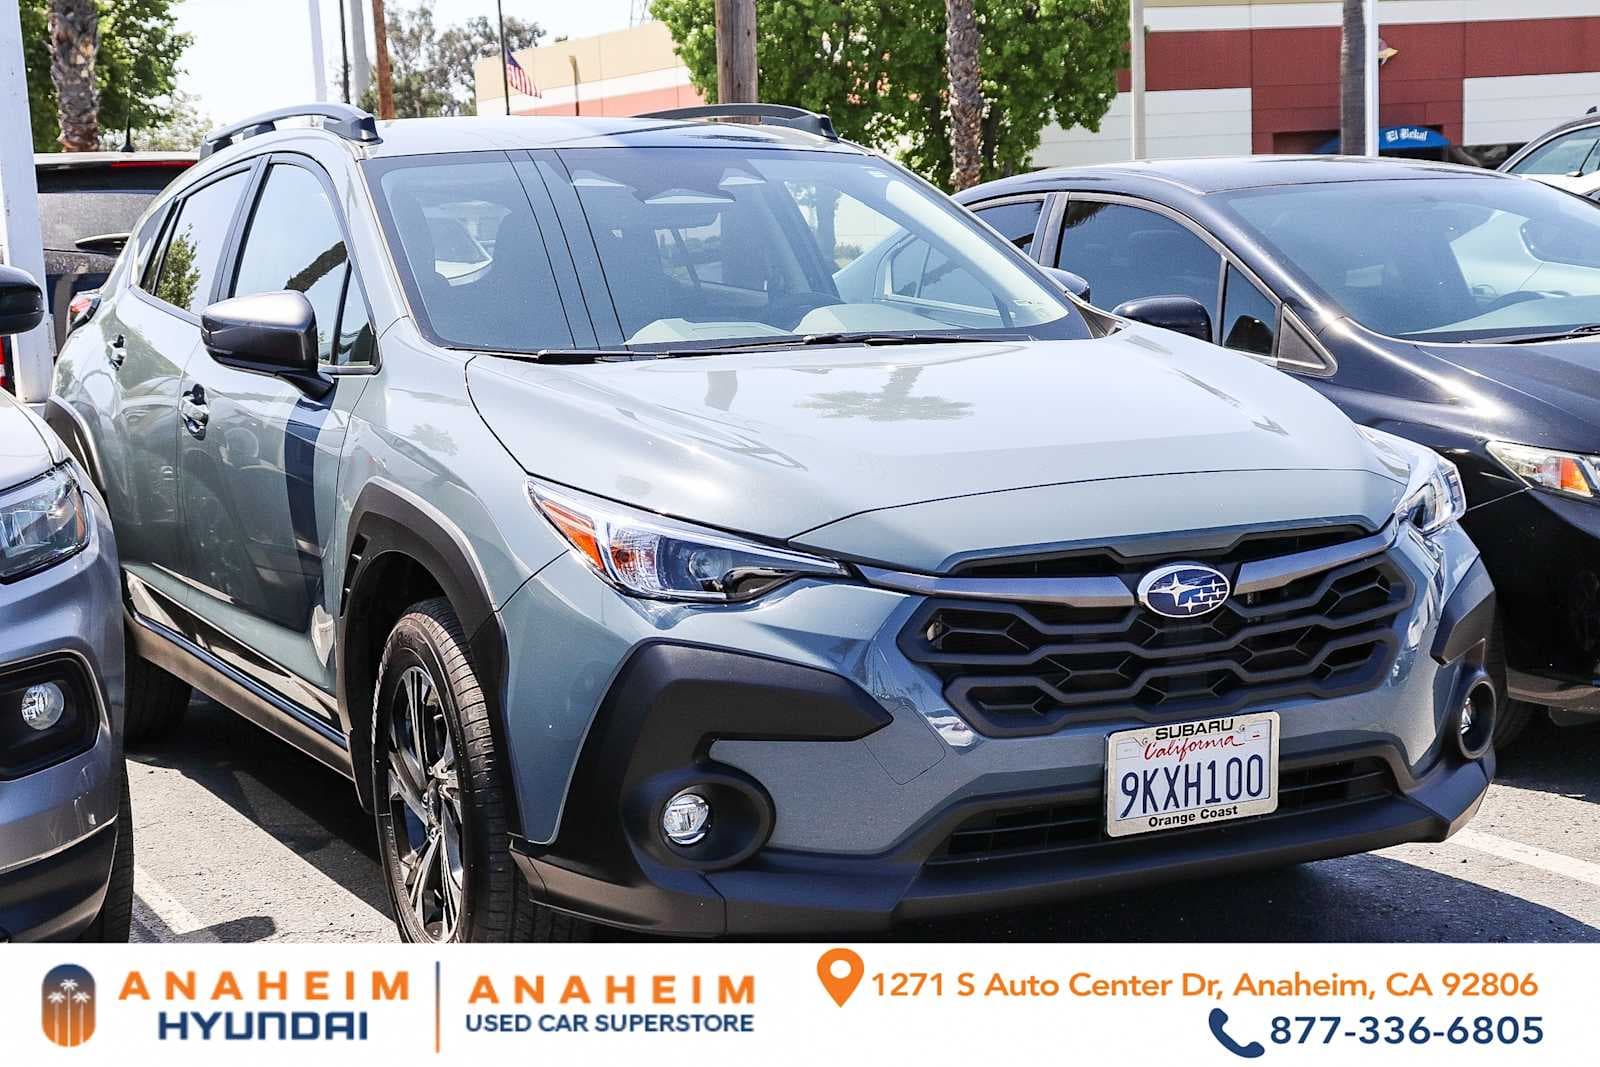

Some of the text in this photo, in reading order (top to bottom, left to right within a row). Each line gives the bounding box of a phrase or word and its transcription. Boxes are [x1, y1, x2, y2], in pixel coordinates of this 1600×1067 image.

[1386, 130, 1398, 142] El
[1155, 718, 1234, 741] SUBARU
[1144, 733, 1245, 762] California
[1120, 754, 1264, 819] 9KXH100
[1148, 804, 1239, 828] Orange Coast
